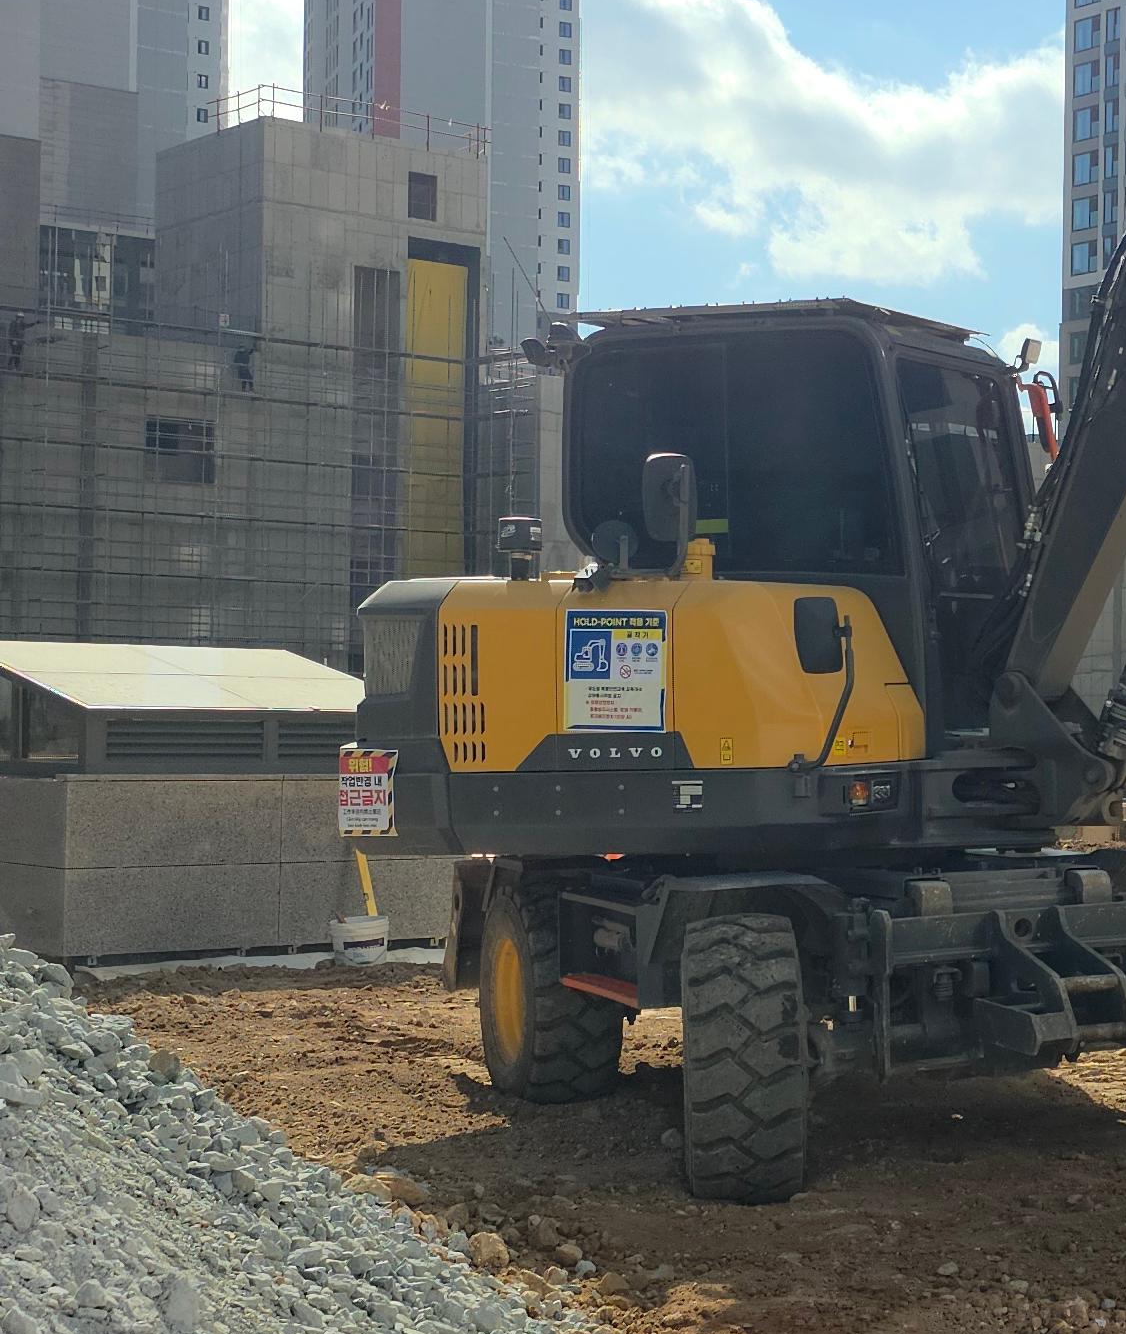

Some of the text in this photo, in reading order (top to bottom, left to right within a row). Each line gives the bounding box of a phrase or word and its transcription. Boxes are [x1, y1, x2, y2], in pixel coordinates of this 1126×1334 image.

[573, 617, 627, 627] HOLD-POINT
[568, 746, 663, 759] VOLVO
[348, 758, 373, 773] 위험!
[341, 775, 382, 787] 작업반경 내
[339, 789, 387, 806] 접근금지
